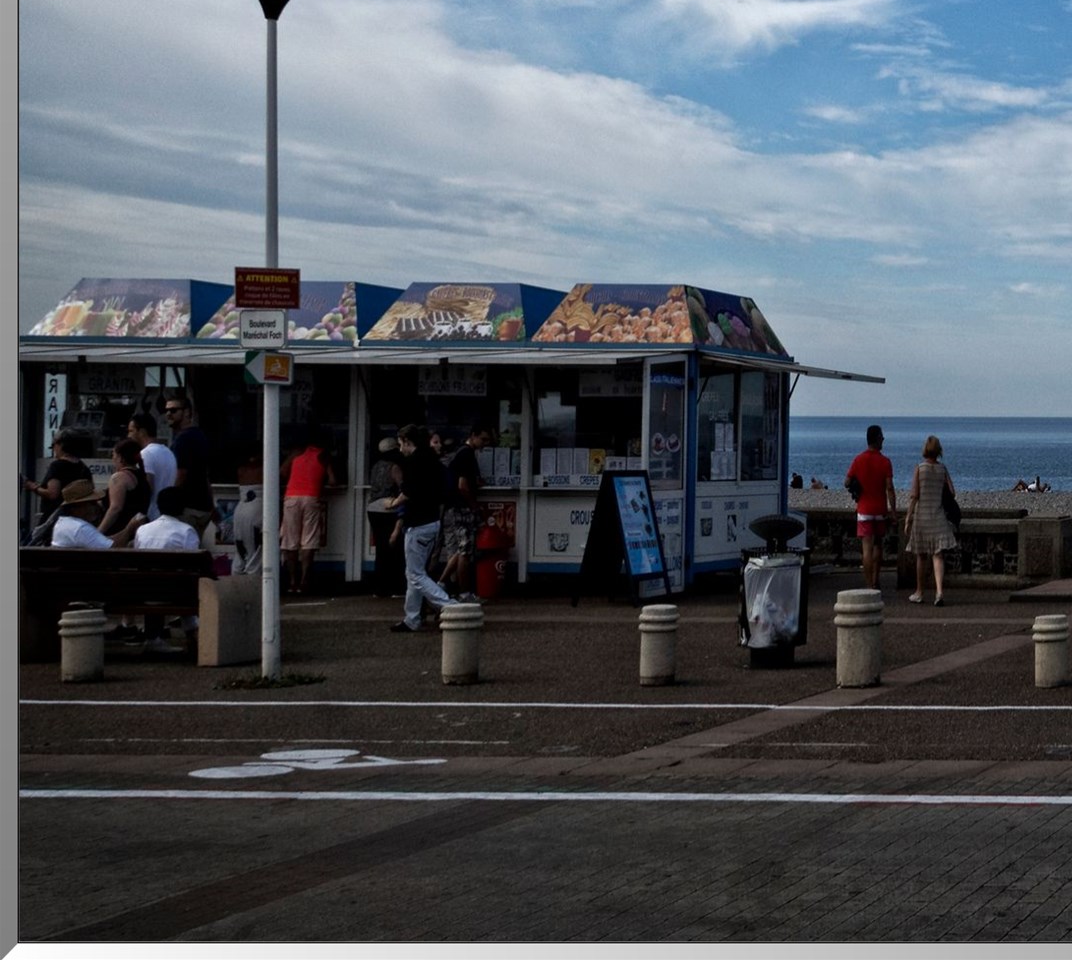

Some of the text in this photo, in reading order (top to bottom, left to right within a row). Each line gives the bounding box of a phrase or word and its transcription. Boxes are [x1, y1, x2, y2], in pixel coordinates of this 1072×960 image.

[246, 274, 289, 283] ATTENTION
[249, 320, 276, 328] Boulevard
[243, 331, 282, 339] Maréchal Foch
[88, 378, 136, 391] GRANITA
